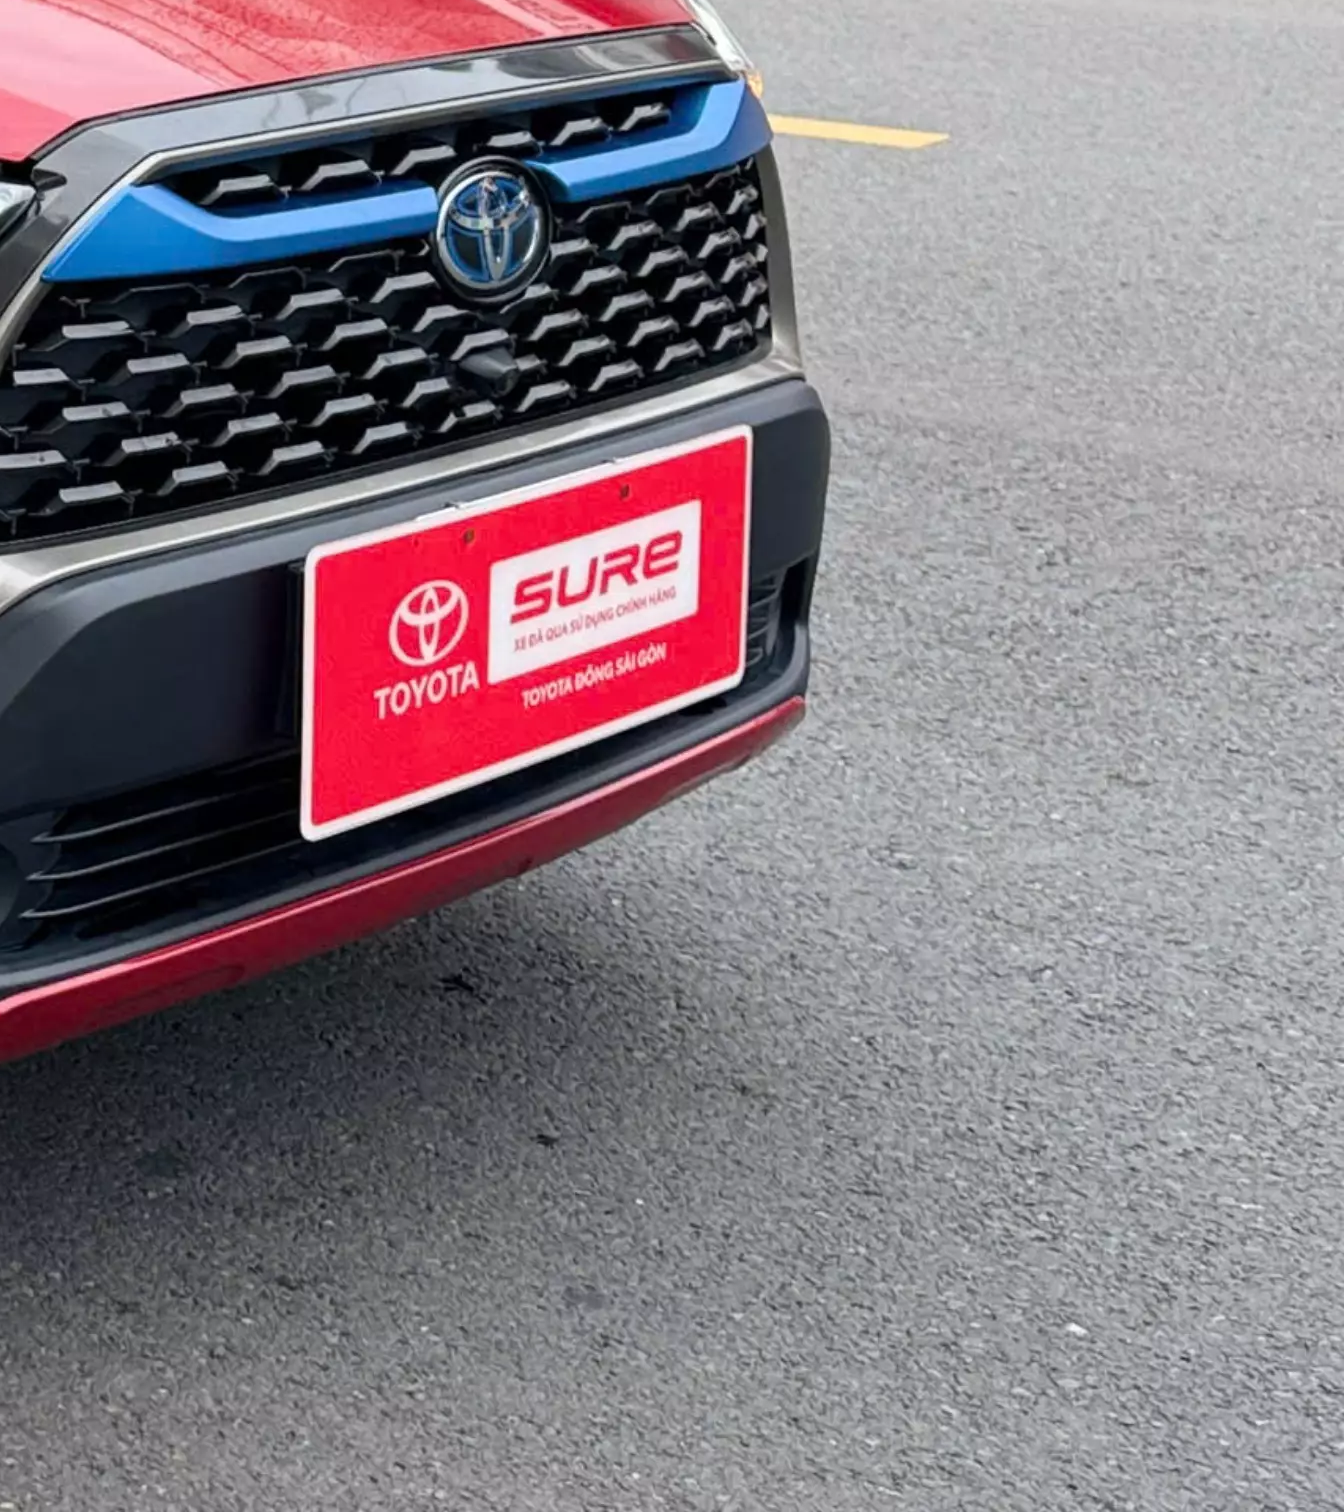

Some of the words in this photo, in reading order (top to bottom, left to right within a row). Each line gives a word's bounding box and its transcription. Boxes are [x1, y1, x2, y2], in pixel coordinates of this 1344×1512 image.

[545, 623, 568, 643] QUA
[615, 596, 647, 618] CHÍNH
[373, 660, 480, 720] TOYOTA
[521, 676, 573, 709] TOYOTA
